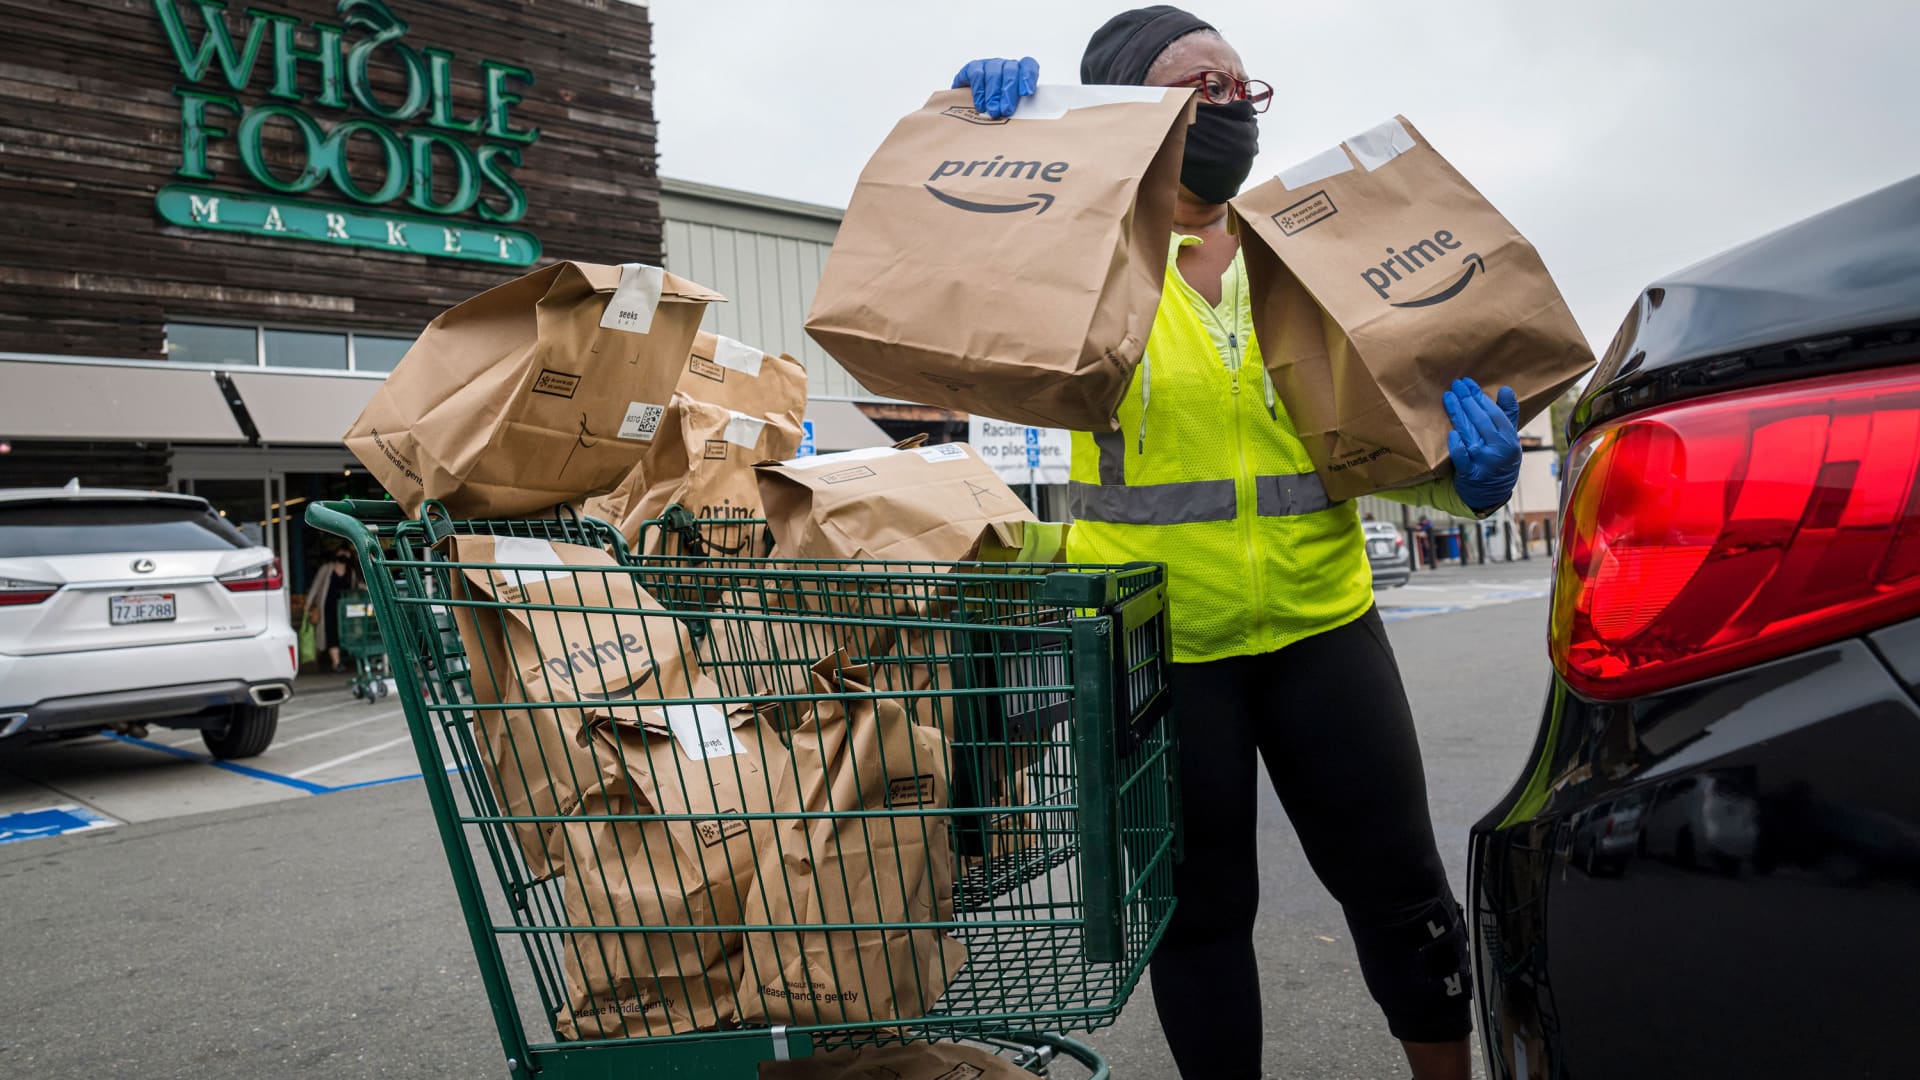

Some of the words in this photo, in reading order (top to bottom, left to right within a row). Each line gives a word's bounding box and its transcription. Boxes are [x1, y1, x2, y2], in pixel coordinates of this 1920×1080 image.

[153, 0, 540, 143] WHOLE
[172, 86, 528, 223] FOODS
[928, 154, 1070, 183] prime
[189, 195, 513, 260] MARKET
[1359, 228, 1463, 300] prime
[982, 444, 998, 456] no
[1001, 442, 1026, 459] plac
[545, 633, 644, 685] prime
[1427, 920, 1446, 938] L
[1443, 972, 1462, 996] R
